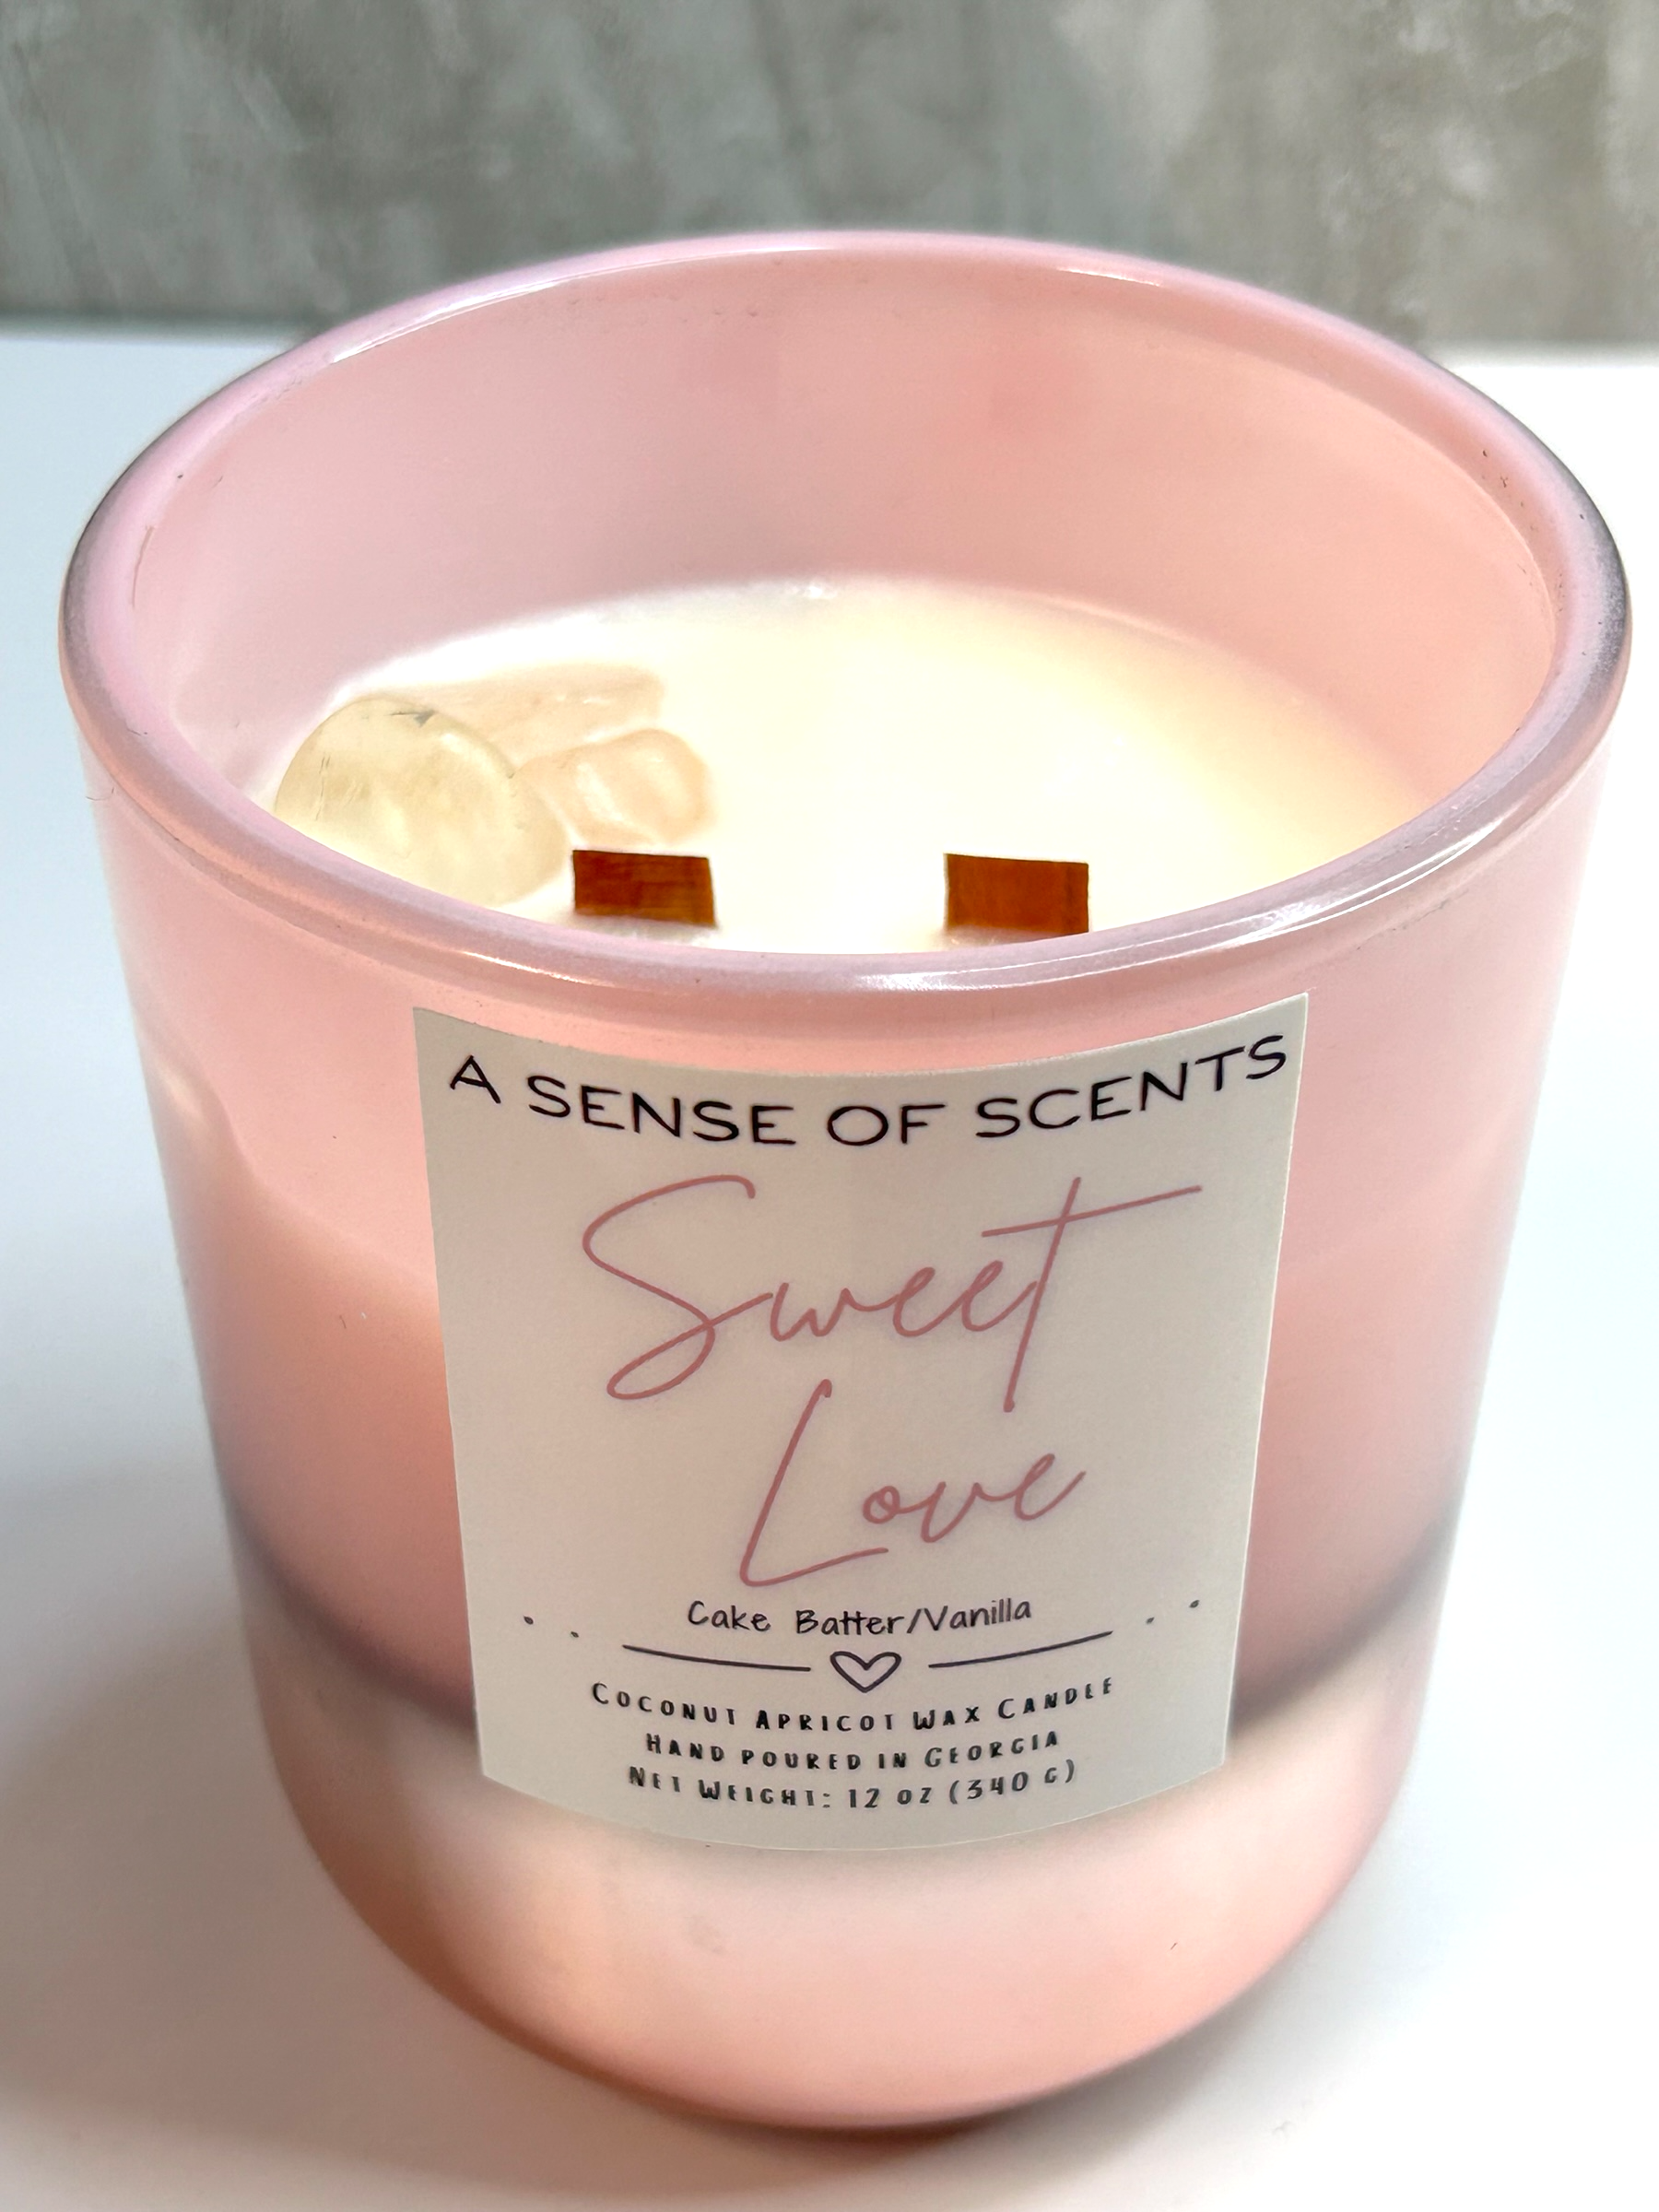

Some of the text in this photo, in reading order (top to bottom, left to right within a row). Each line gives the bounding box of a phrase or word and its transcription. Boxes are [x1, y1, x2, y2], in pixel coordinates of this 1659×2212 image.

[448, 1034, 1287, 1147] A SENSE OF SCENTS
[582, 1174, 1202, 1413] Sweet
[739, 1379, 1086, 1587] Love
[688, 1598, 1031, 1636] Cake Batter/Vanilla
[591, 1677, 1112, 1732] COCONUT APRICOT WAX CANDLE
[645, 1731, 1059, 1770] HAND POURED IN GEORGIA
[628, 1766, 680, 1793] NET
[698, 1780, 830, 1808] WEIGHT:
[849, 1788, 880, 1808] 12
[949, 1771, 1030, 1805] (340
